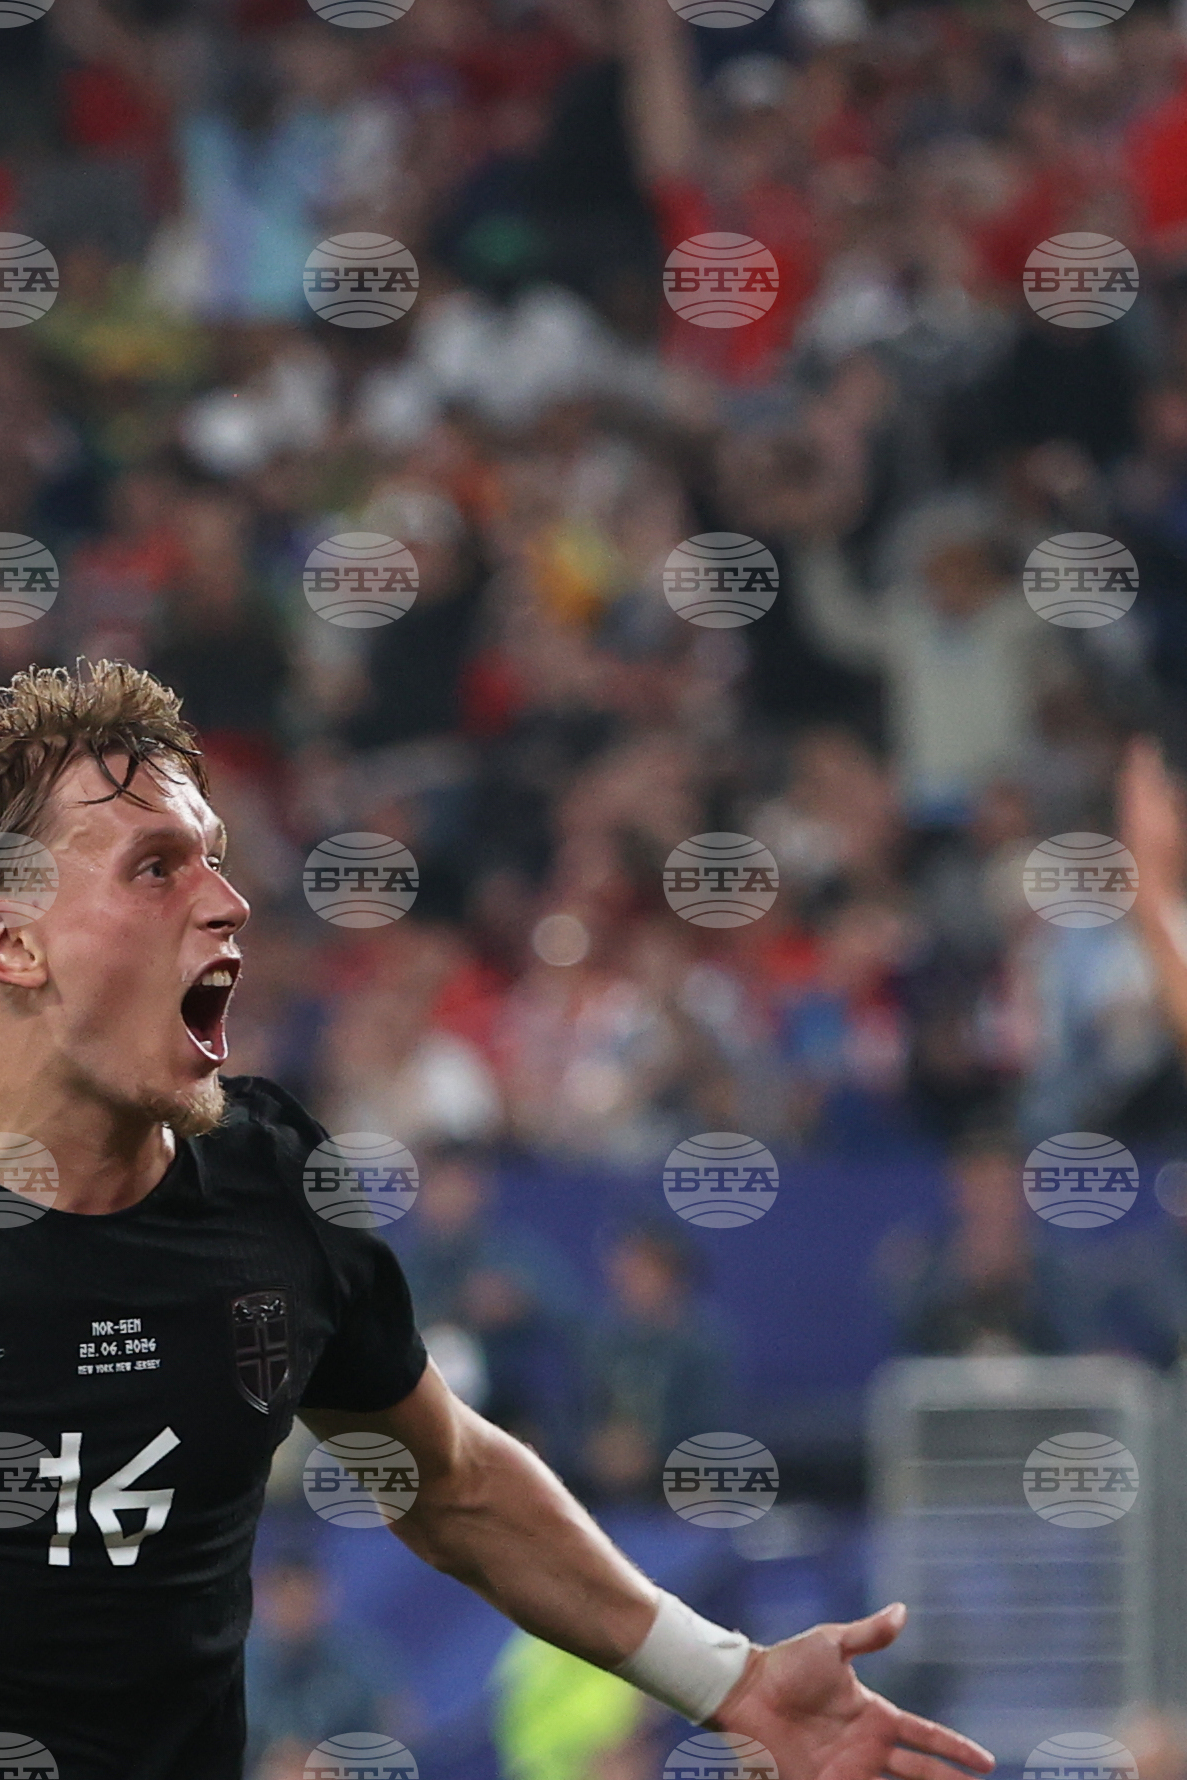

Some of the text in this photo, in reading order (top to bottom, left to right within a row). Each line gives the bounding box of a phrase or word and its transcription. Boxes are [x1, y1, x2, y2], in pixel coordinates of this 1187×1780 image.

[92, 1318, 141, 1336] NOR-SEN
[77, 1358, 161, 1375] NEW YORK NEW JERSEY
[39, 1426, 181, 1566] 16
